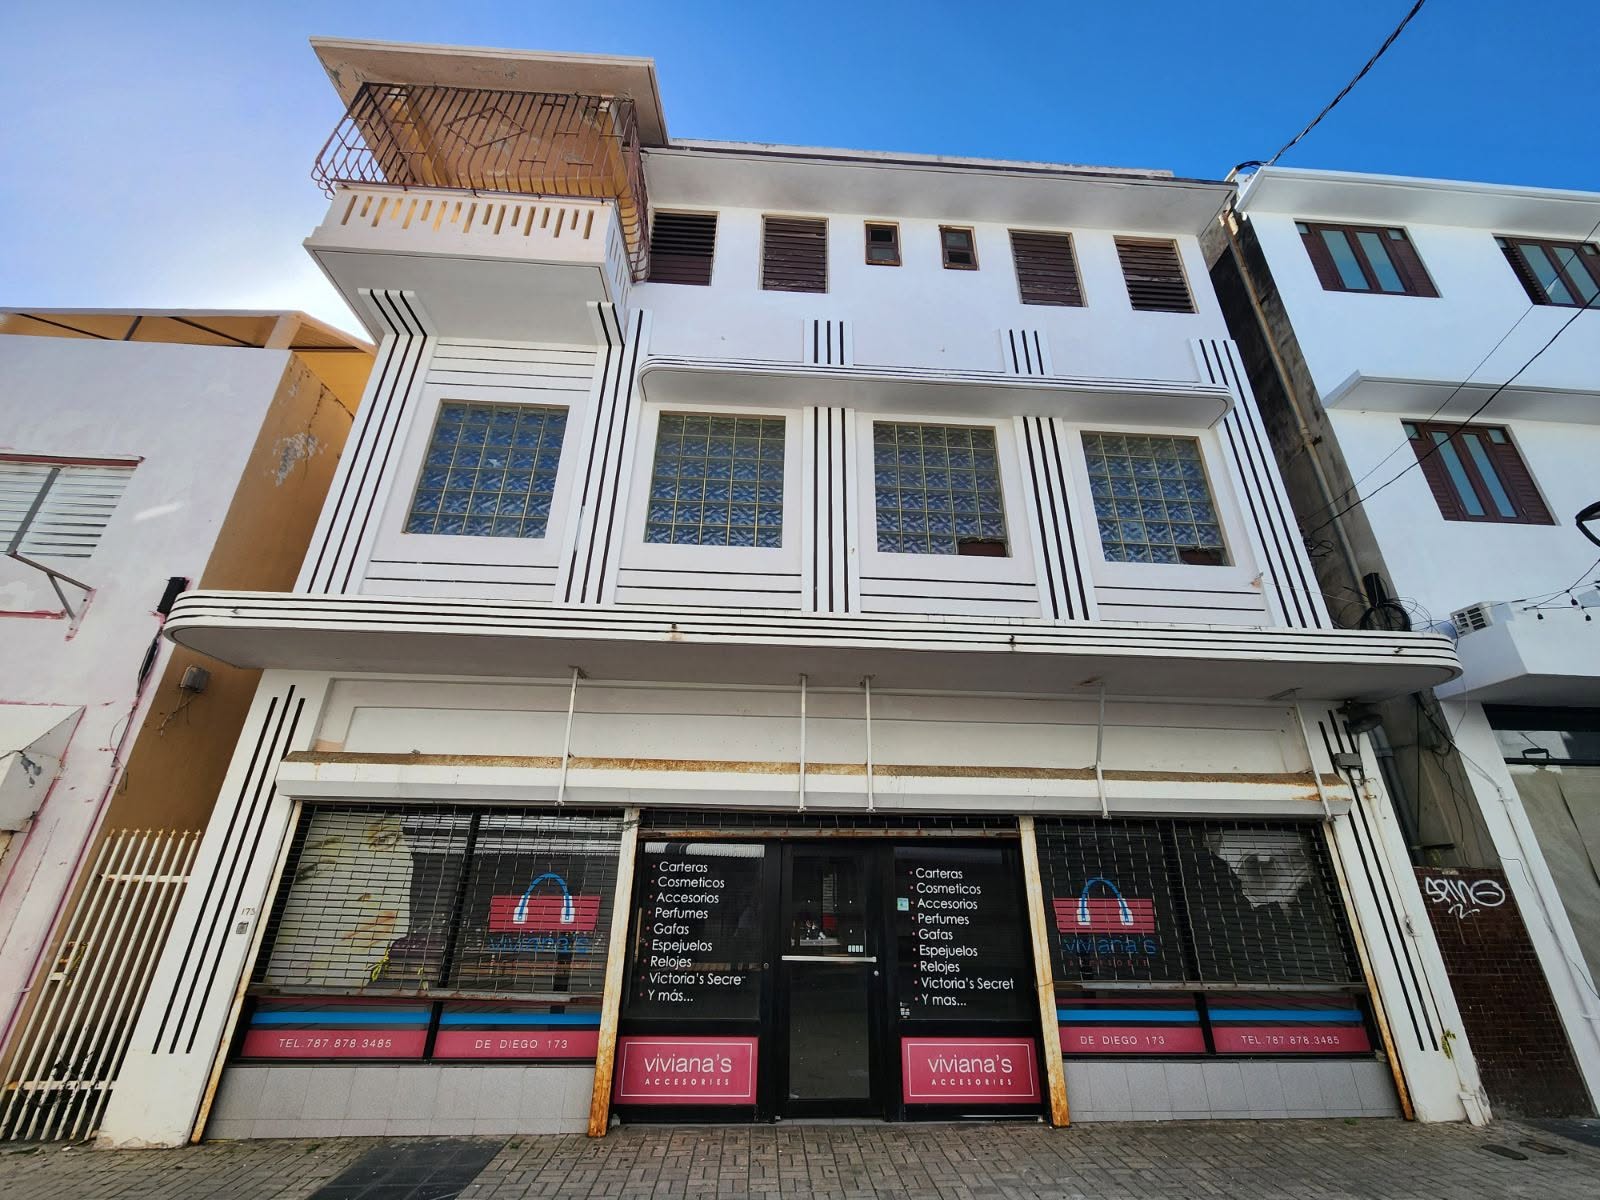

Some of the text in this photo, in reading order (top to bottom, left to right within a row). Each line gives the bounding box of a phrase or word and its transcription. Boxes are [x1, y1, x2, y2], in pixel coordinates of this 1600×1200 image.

[659, 861, 708, 873] Carteras
[915, 867, 963, 879] Carteras
[658, 876, 725, 889] Cosmeticos
[916, 882, 982, 895] Cosmeticos
[656, 892, 720, 904] Accesorios
[917, 898, 978, 910] Accesorios
[655, 907, 709, 919] Perfumes
[917, 913, 970, 925] Perfumes
[653, 922, 690, 935] Gafas
[918, 928, 954, 940] Gafas
[652, 939, 713, 953] Espejuelos
[919, 944, 978, 959] Espejuelos
[650, 955, 692, 970] Relojes
[920, 960, 960, 975] Relojes
[649, 972, 704, 985] Victoria's
[921, 976, 1014, 990] Victoria's Secret
[647, 988, 656, 1001] Y
[921, 993, 929, 1005] Y
[475, 1039, 568, 1049] DE DIEGO 173
[1080, 1035, 1165, 1045] DE DIEGO 173
[644, 1053, 732, 1073] viviana's
[927, 1054, 1013, 1073] viviana's
[644, 1078, 729, 1086] ACCESORIES
[931, 1078, 1012, 1086] ACCESORIES
